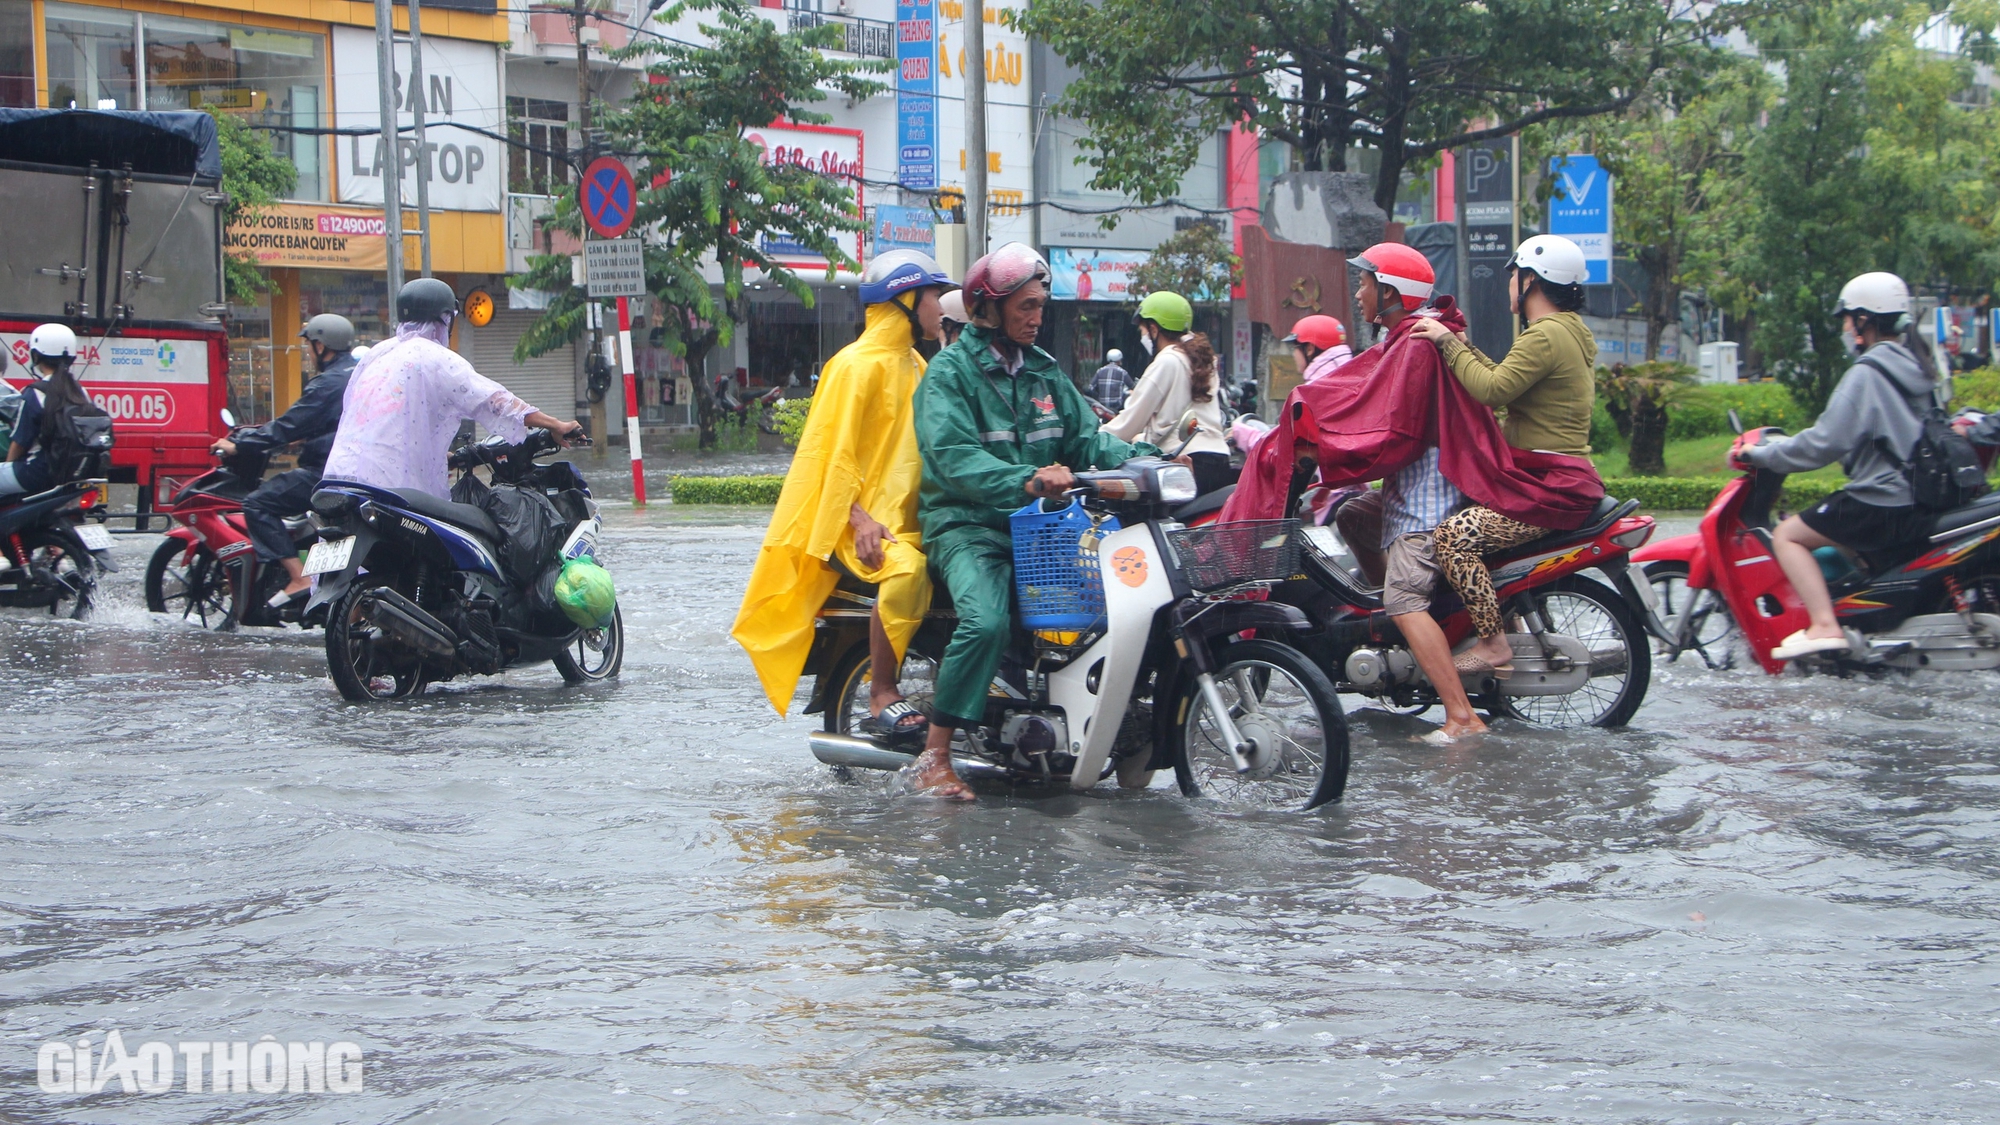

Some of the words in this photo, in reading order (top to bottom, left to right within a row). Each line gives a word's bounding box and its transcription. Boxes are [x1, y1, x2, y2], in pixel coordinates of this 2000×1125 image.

[902, 57, 929, 80] QUAN
[351, 135, 485, 184] LAPTOP
[1486, 206, 1511, 214] PLAZA
[261, 214, 289, 229] CORE
[249, 233, 285, 248] OFFICE
[895, 221, 933, 243] THẮNG
[886, 272, 922, 288] APOLLO
[400, 517, 428, 535] YAMAHA
